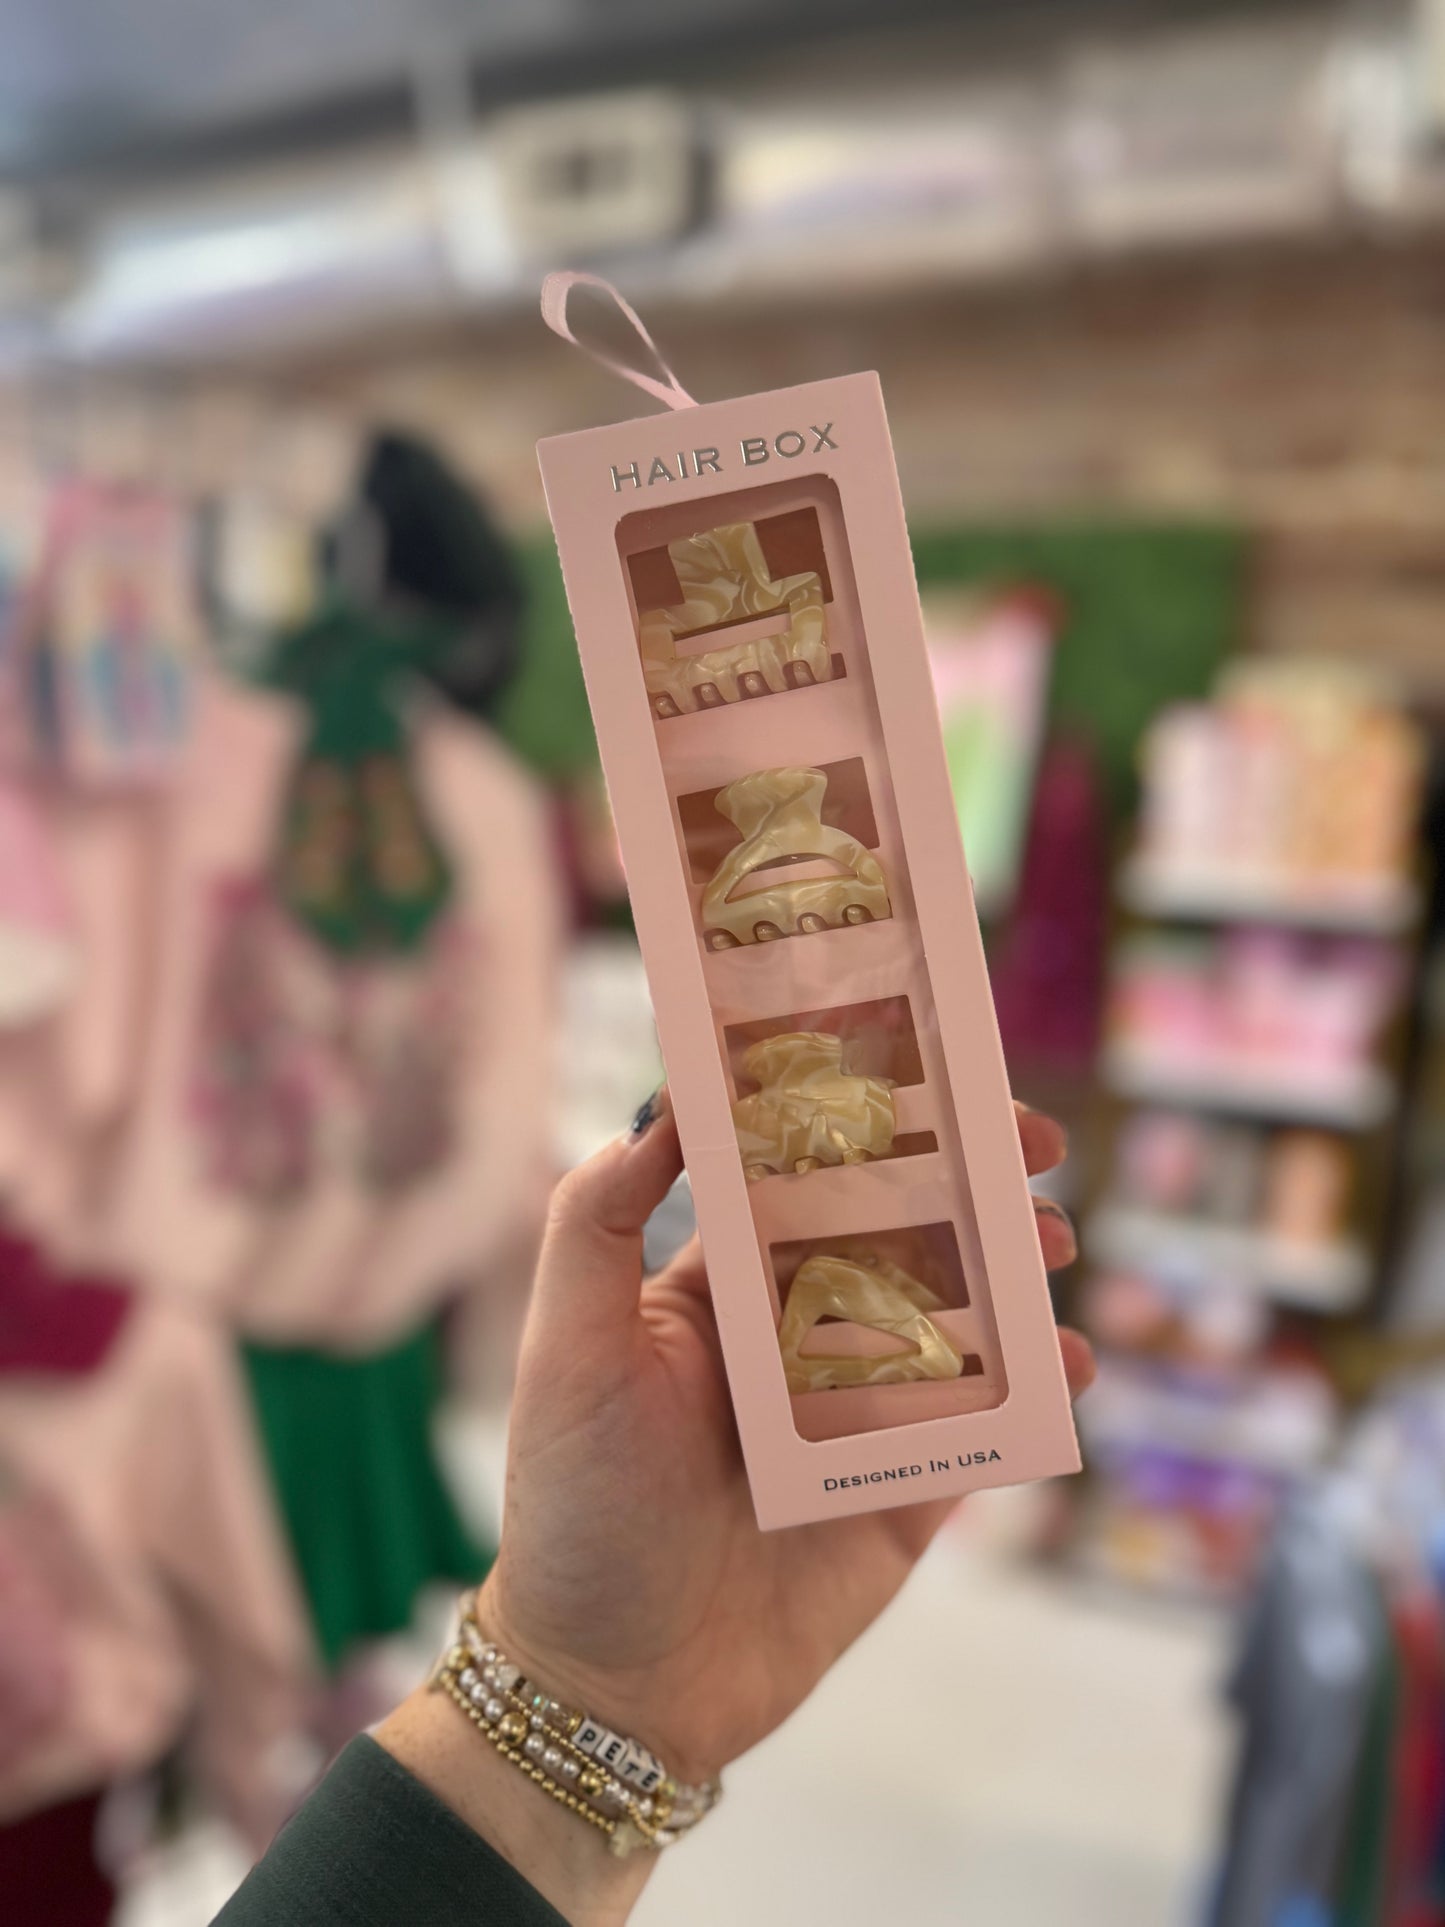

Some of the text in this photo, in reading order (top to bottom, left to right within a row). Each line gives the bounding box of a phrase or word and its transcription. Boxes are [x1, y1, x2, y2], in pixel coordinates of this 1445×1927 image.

[609, 422, 839, 492] HAIR BOX
[823, 1449, 1002, 1491] DESIGNED IN USA
[578, 1728, 659, 1788] PETE
